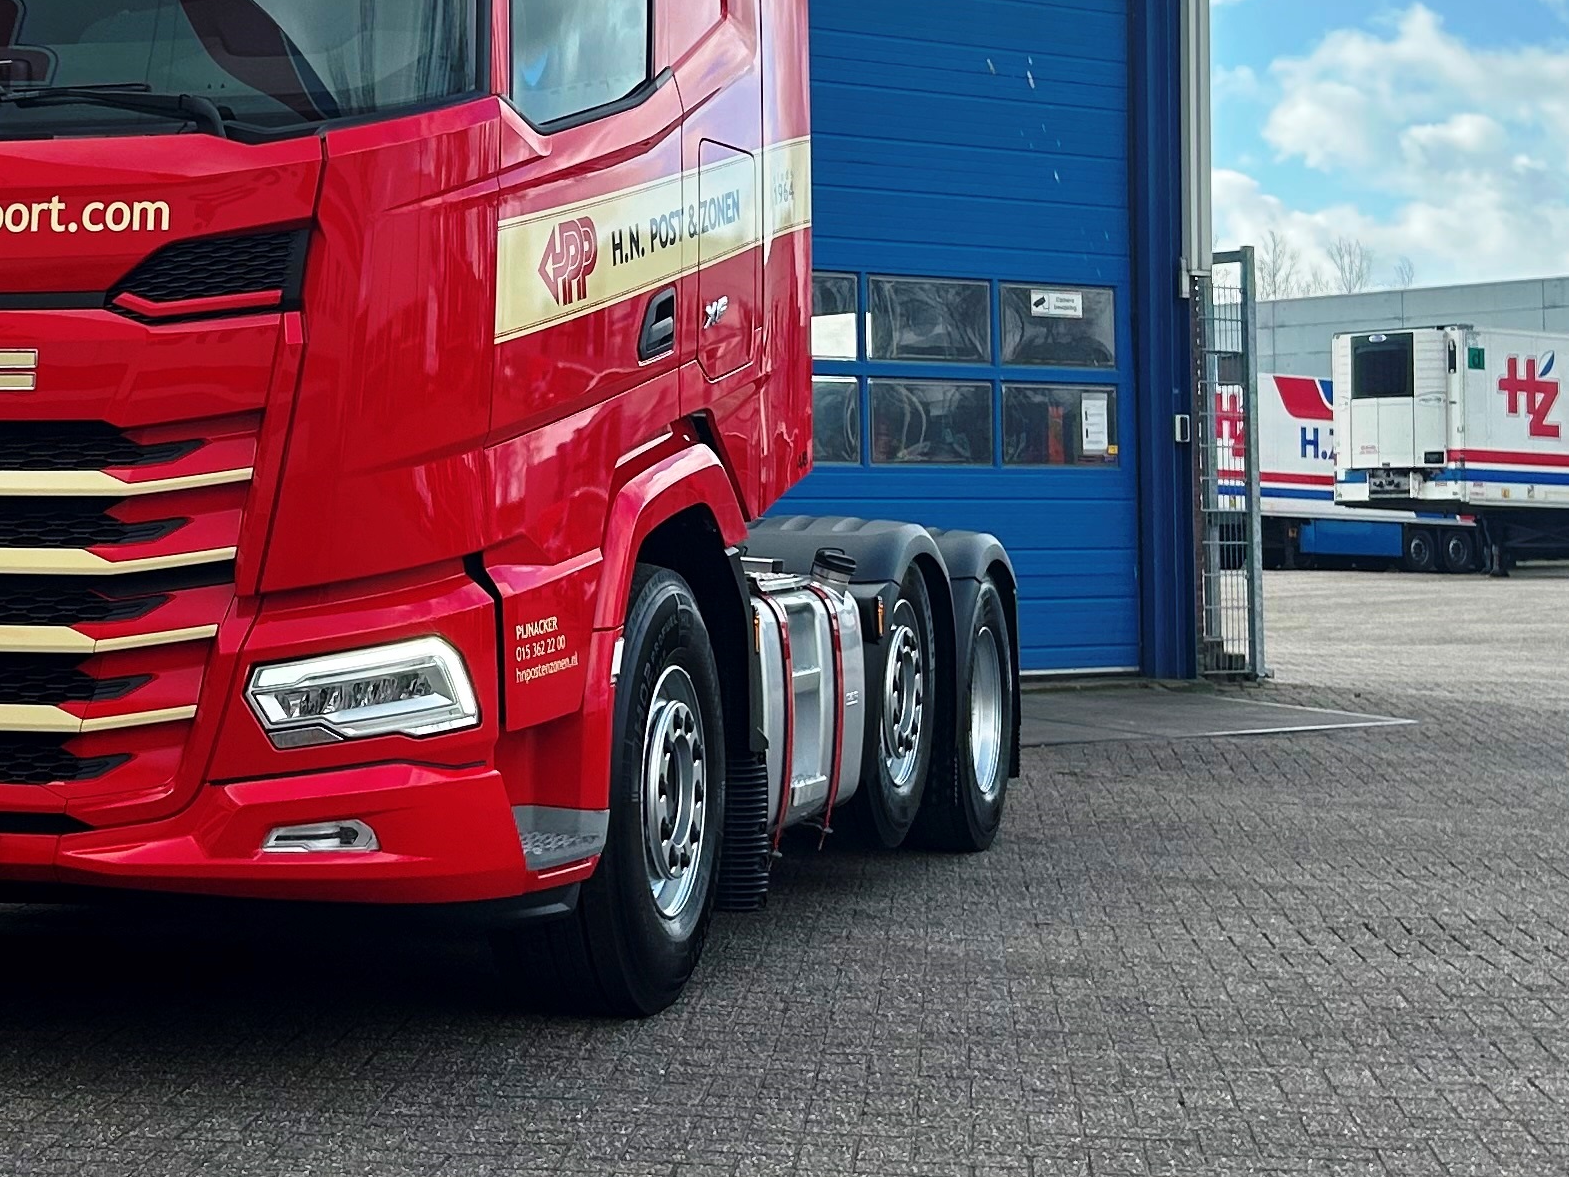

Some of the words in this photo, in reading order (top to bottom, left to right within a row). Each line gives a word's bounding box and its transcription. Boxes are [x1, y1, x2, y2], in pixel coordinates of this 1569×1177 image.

[611, 223, 645, 267] H.N.
[649, 207, 684, 253] POST
[687, 204, 699, 238] &
[700, 189, 740, 234] ZONEN
[1499, 357, 1560, 438] HZ
[515, 644, 531, 662] 015
[532, 640, 546, 658] 362
[546, 637, 556, 654] 22
[556, 634, 566, 651] 00
